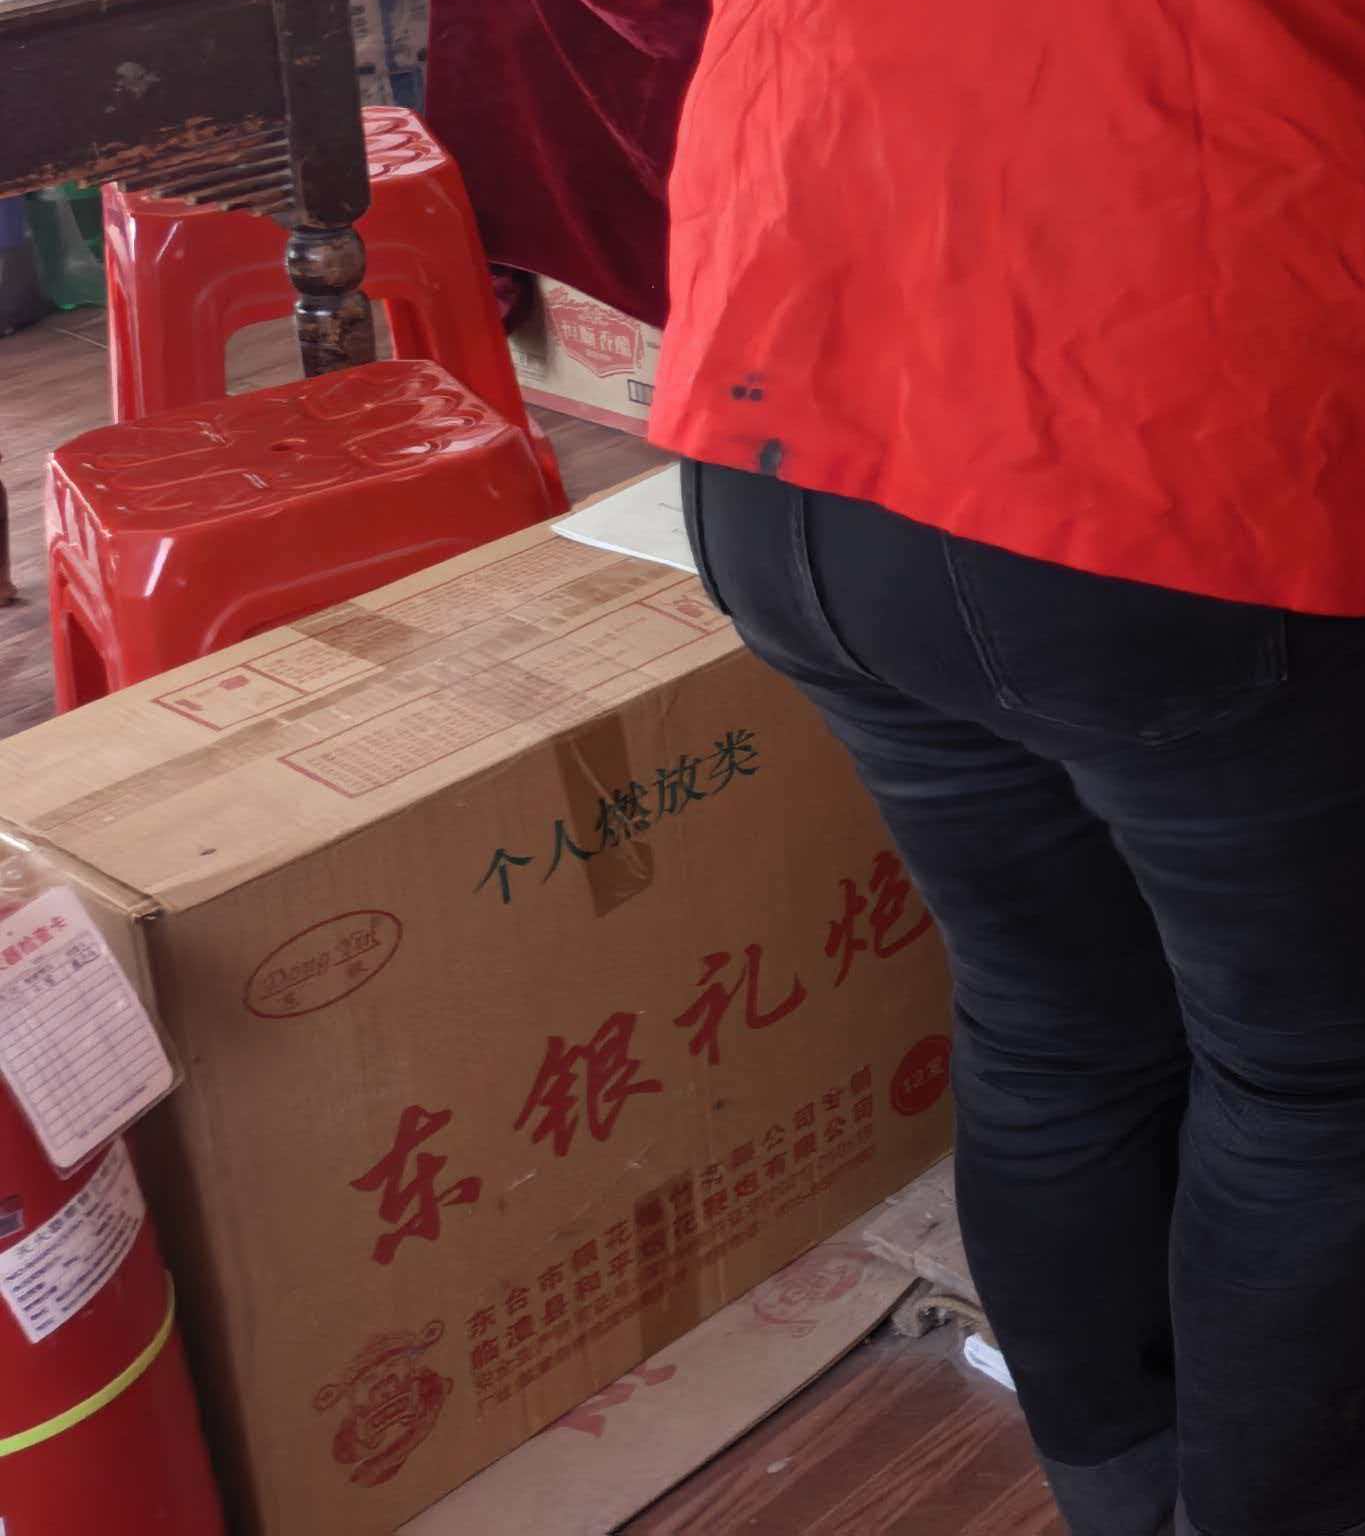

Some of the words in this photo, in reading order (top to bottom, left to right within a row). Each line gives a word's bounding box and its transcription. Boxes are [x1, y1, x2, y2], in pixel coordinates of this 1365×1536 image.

[475, 728, 758, 904] 个人燃放类
[349, 849, 933, 1265] 东银礼炮
